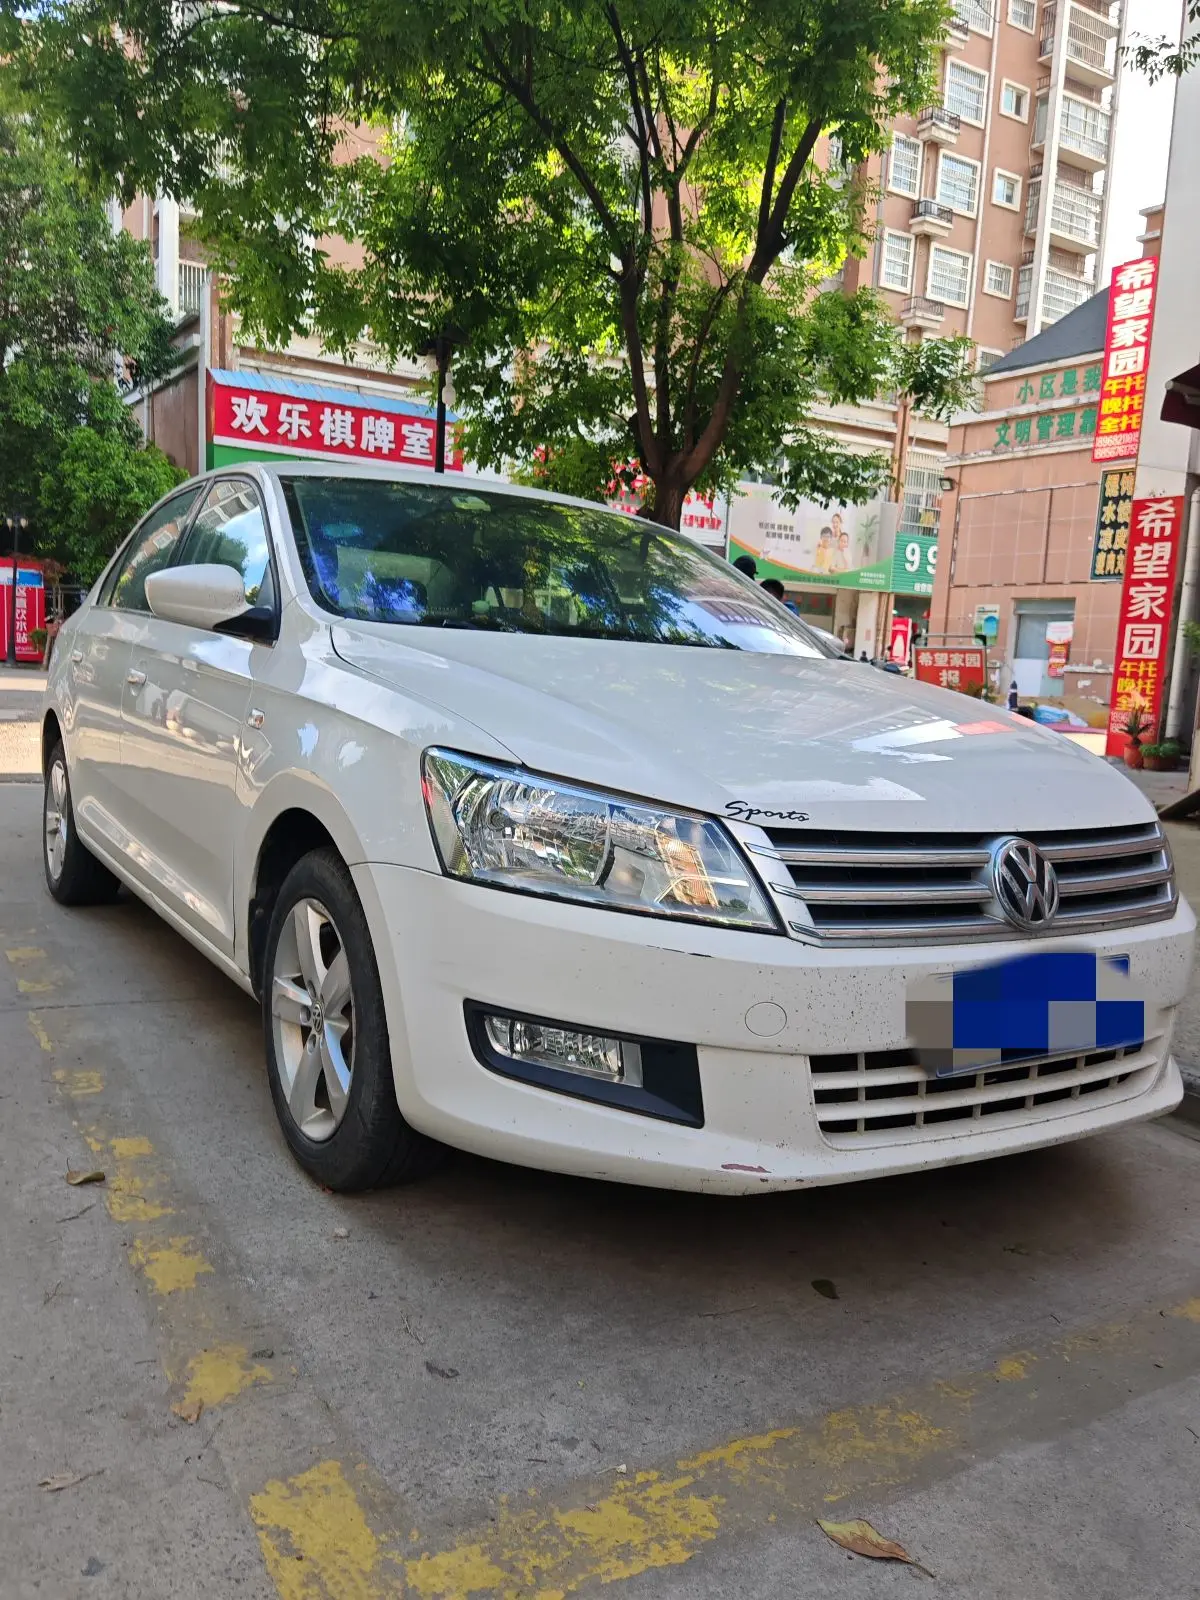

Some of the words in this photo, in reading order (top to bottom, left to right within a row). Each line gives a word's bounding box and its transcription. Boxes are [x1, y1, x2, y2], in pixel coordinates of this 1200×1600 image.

[1108, 260, 1155, 377] 希望家园
[1104, 374, 1145, 395] 午托
[1101, 394, 1143, 415] 晚托
[230, 395, 433, 461] 欢乐棋牌室
[1099, 413, 1141, 434] 全托
[1122, 499, 1176, 659] 希望家园
[918, 651, 981, 668] 希望家园
[1119, 660, 1158, 678] 午托
[1117, 677, 1155, 695] 晚托
[725, 800, 809, 822] Sports
